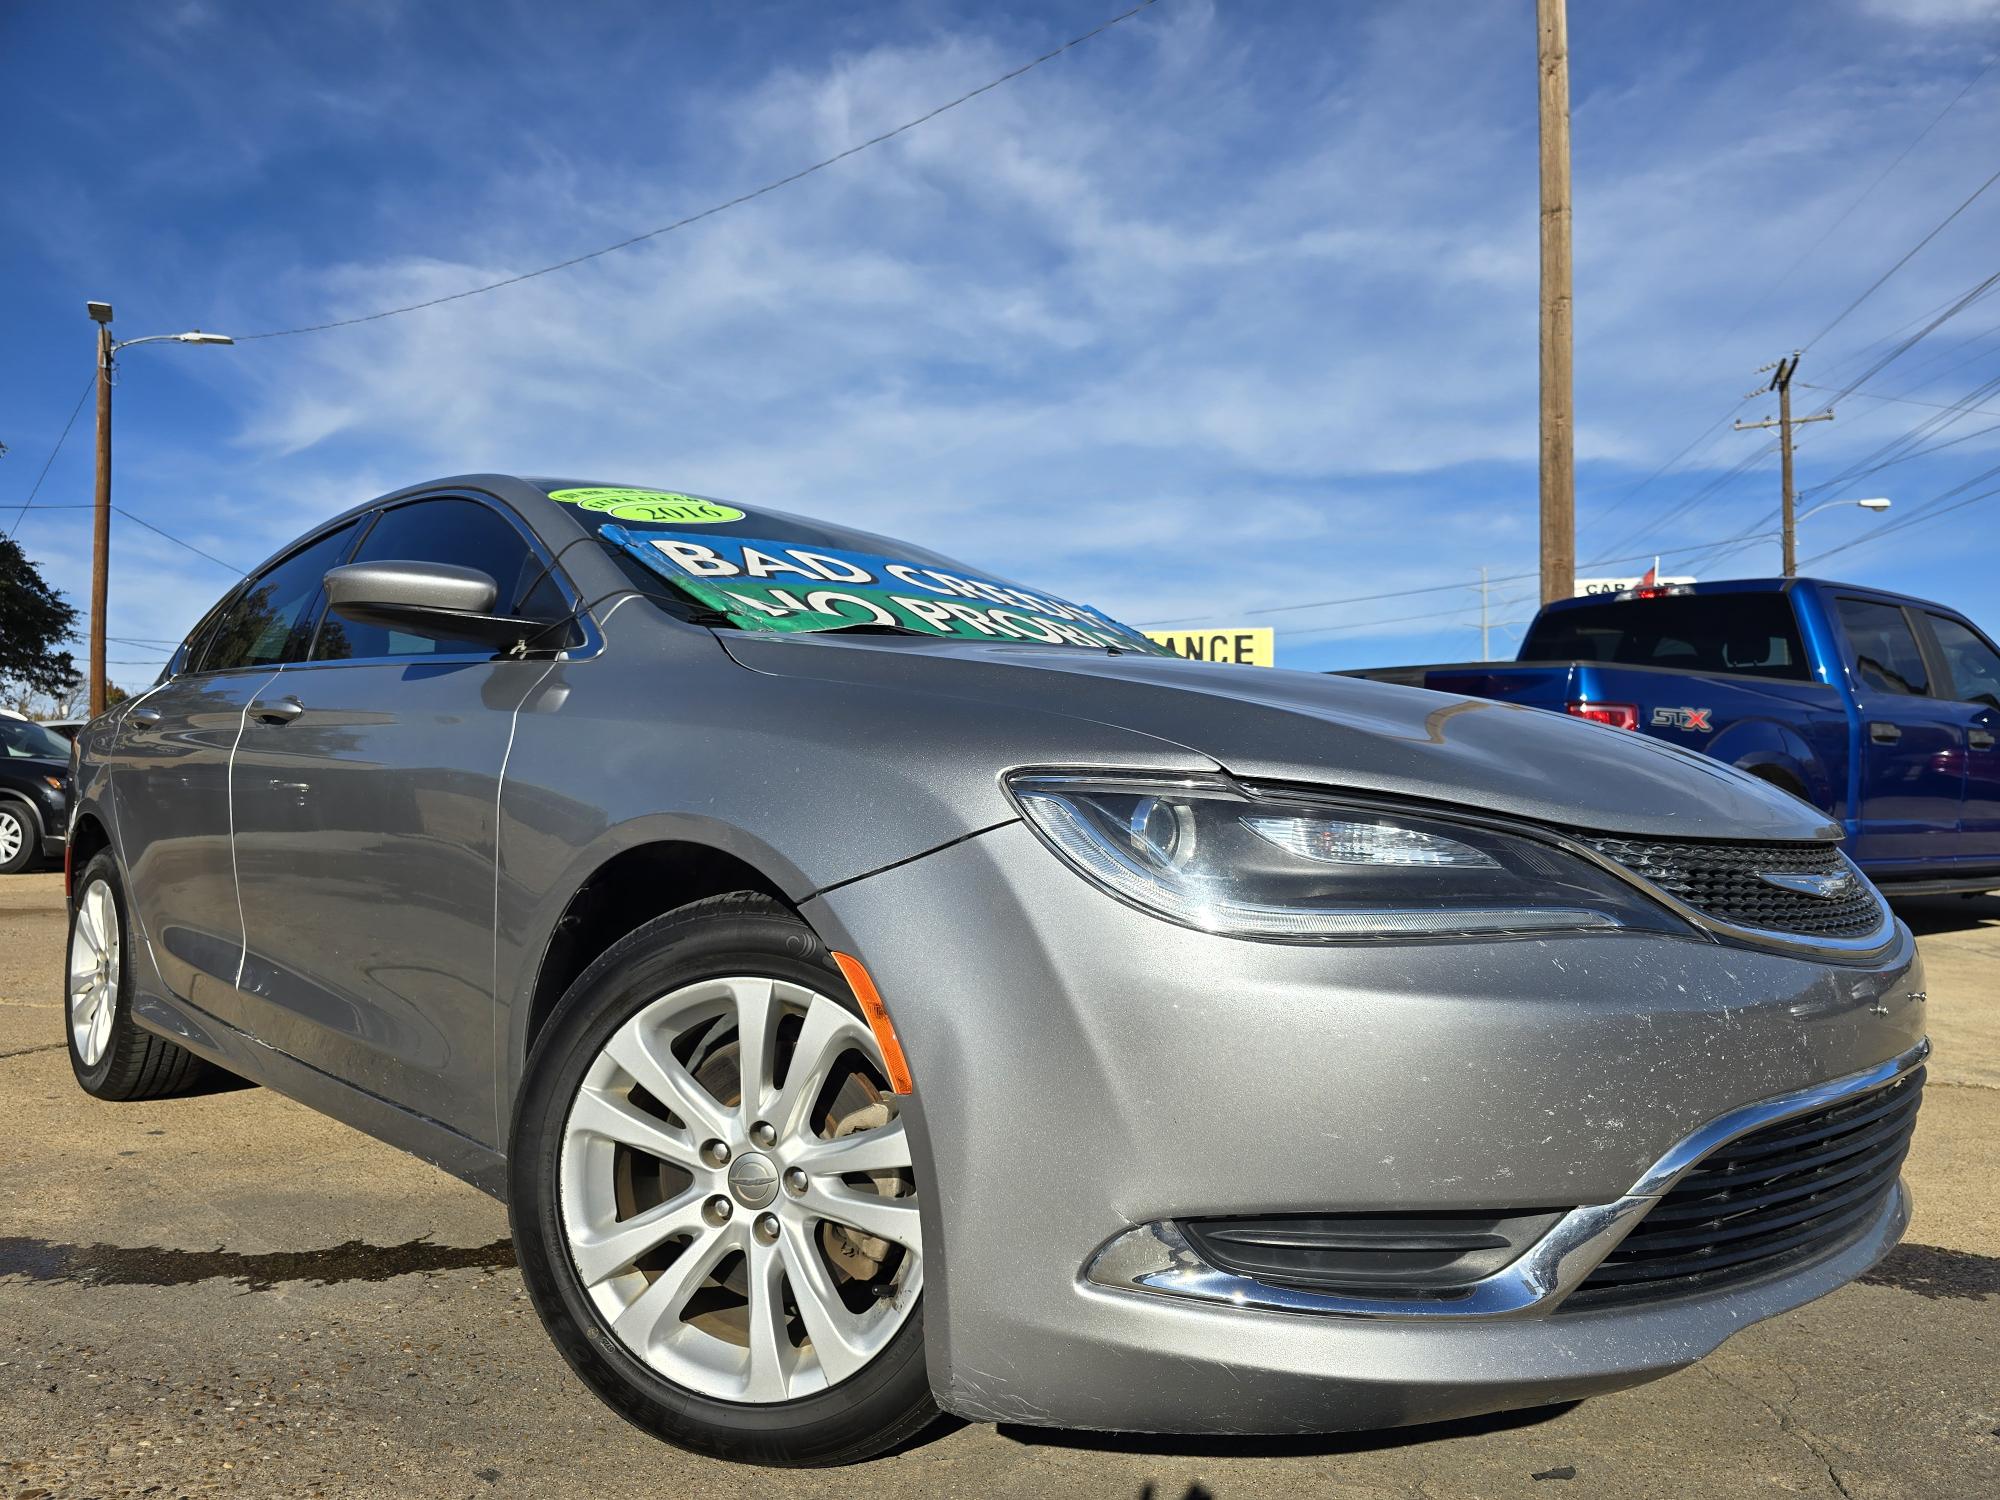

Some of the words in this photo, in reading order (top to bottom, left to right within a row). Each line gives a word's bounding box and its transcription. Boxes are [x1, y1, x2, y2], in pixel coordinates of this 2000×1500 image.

[588, 498, 634, 509] EXTRA
[636, 506, 722, 520] 2016
[649, 540, 872, 583] BAD
[884, 564, 1124, 635] CREDIT
[723, 590, 896, 626] NO
[1652, 707, 1712, 732] STX
